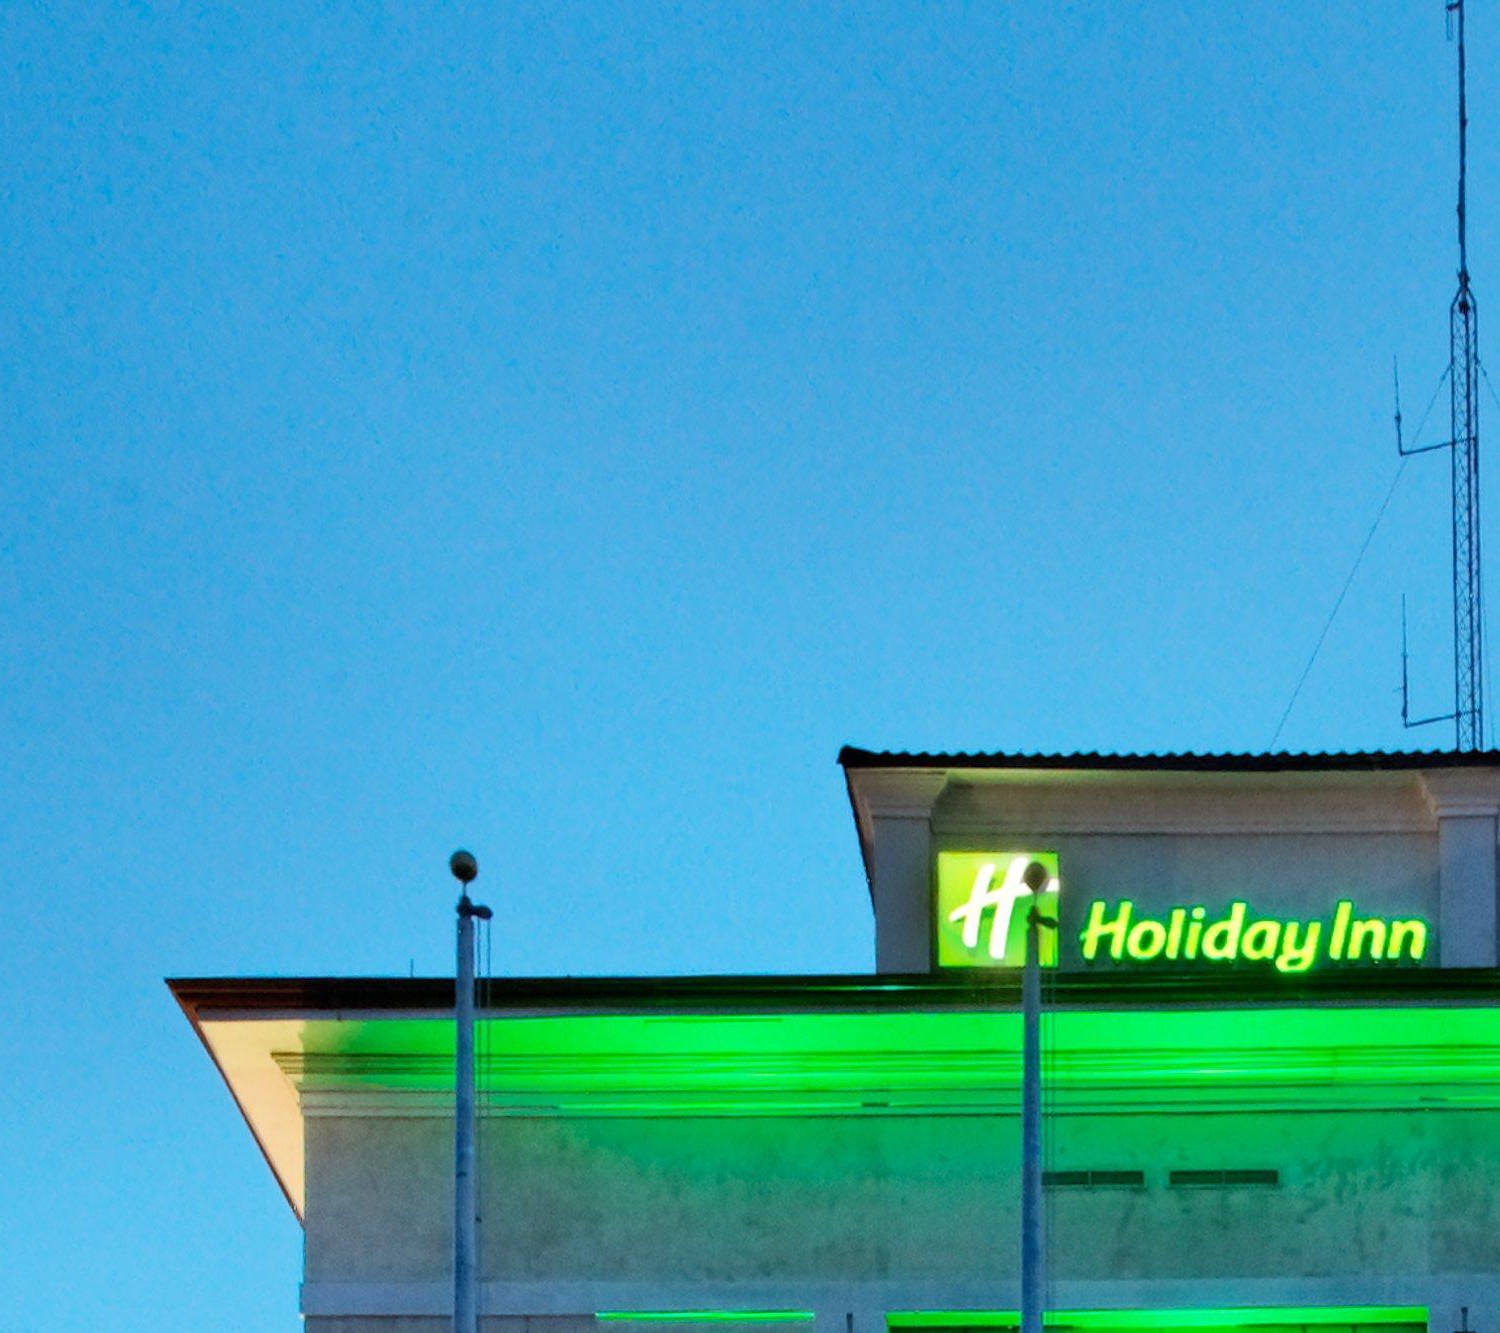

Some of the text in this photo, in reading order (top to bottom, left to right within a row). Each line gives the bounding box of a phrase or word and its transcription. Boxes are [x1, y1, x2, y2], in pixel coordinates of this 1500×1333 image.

[948, 856, 1060, 960] H
[1080, 901, 1427, 972] Holiday Inn
